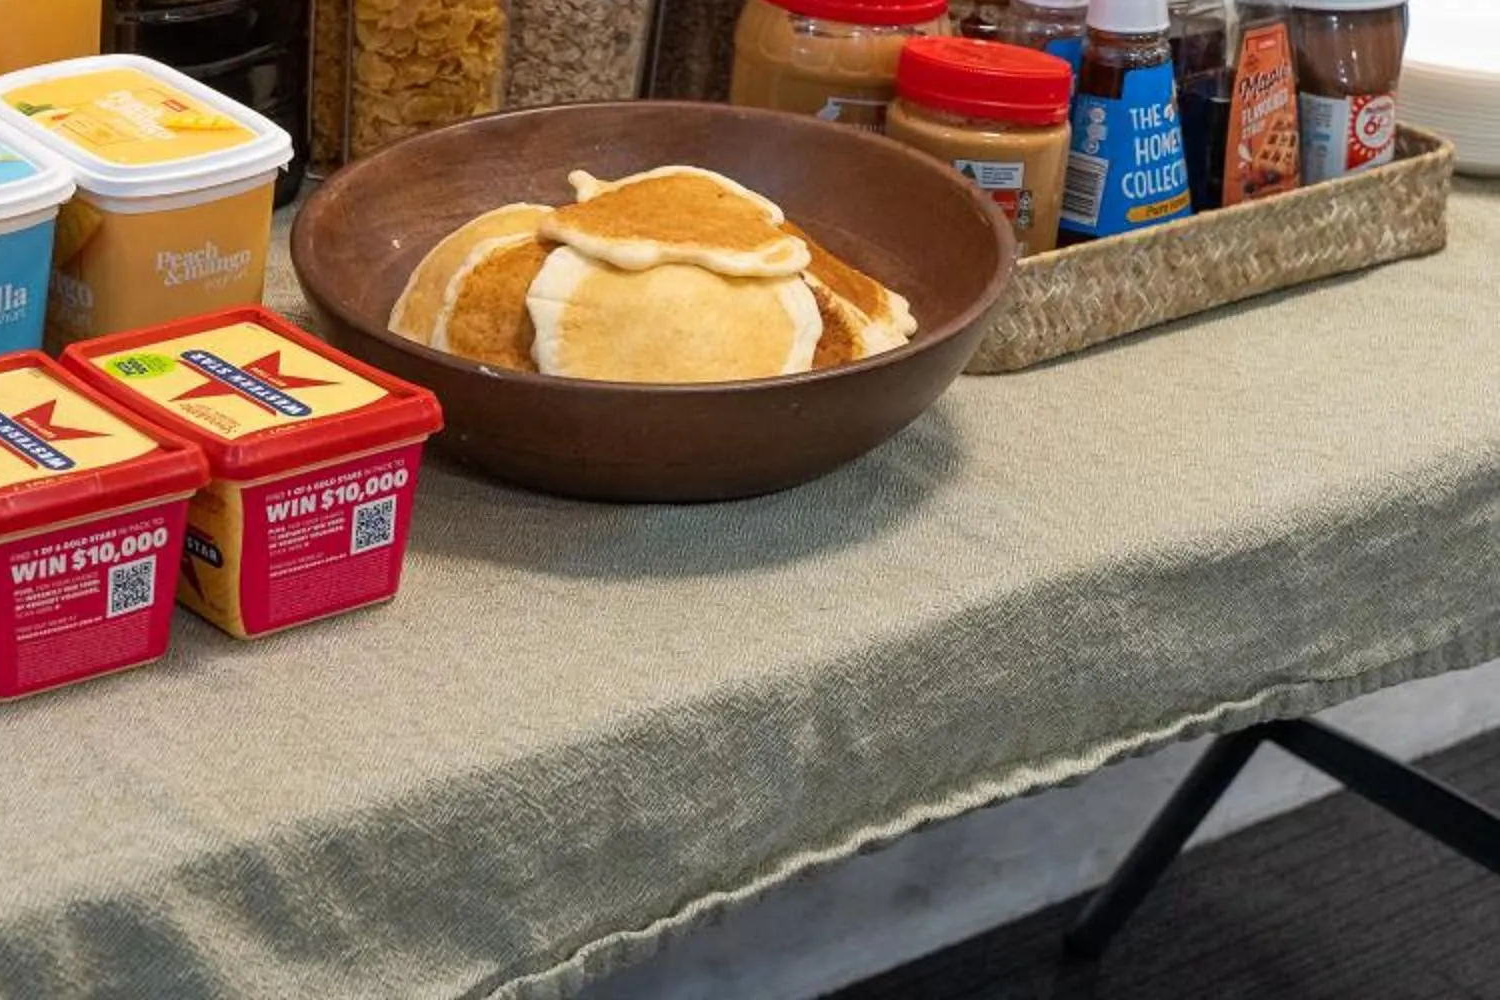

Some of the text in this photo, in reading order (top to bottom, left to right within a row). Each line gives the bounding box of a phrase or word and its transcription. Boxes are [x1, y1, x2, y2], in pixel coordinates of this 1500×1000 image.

[1130, 103, 1162, 130] THE
[1122, 158, 1188, 200] COLLECT
[230, 374, 304, 415] WESTERN
[266, 468, 409, 523] WIN $10,000
[11, 527, 169, 584] WIN $10,000
